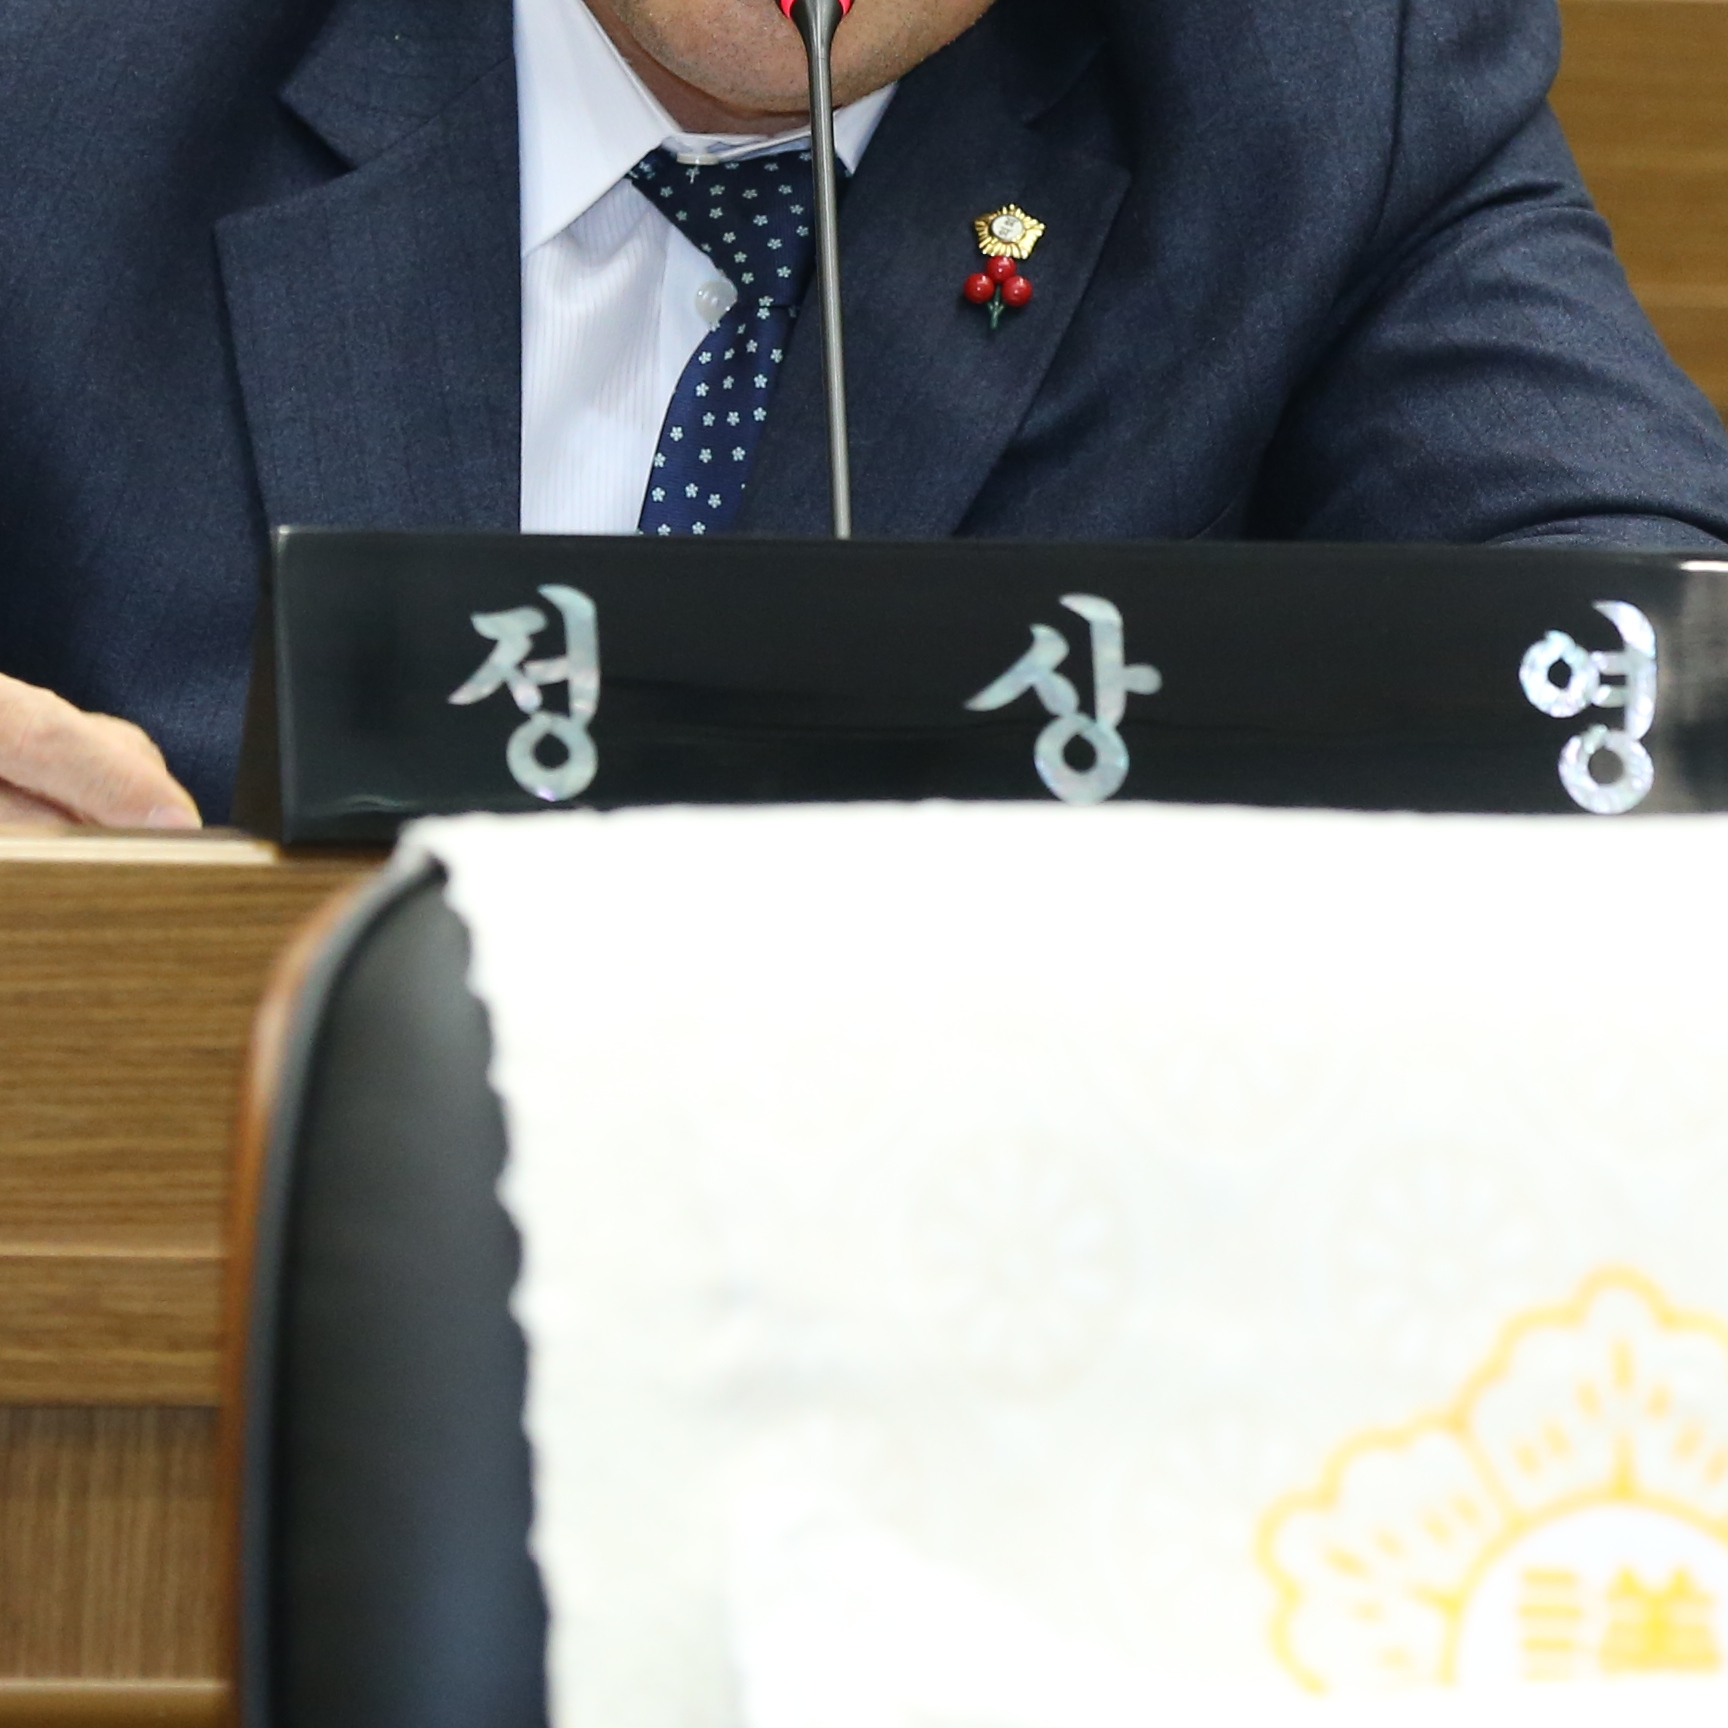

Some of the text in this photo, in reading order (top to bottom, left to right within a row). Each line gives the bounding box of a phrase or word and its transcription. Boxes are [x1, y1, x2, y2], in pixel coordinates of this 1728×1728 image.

[448, 584, 1657, 815] 정 상 영
